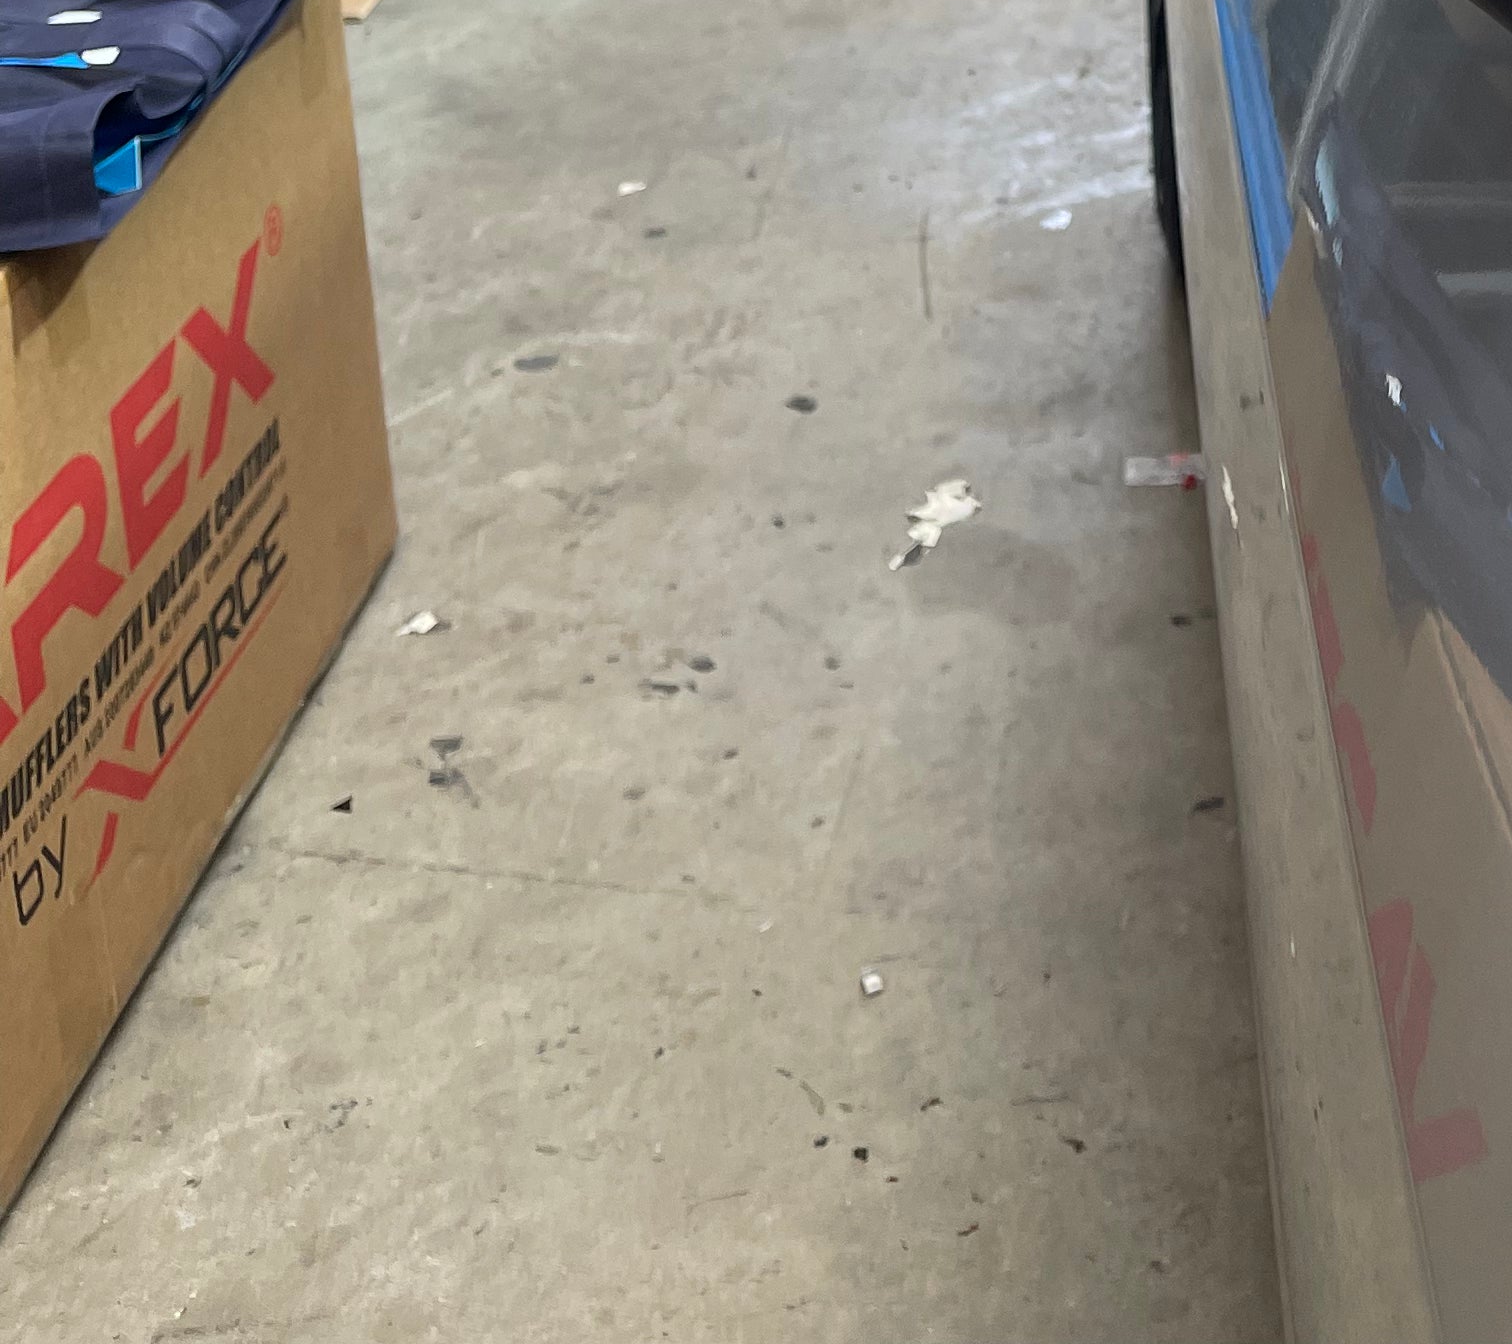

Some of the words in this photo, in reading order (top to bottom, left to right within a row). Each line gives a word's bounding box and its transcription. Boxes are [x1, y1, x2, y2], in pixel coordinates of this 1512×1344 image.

[0, 236, 276, 748] REX
[94, 600, 143, 703] WITH
[13, 813, 68, 927] by
